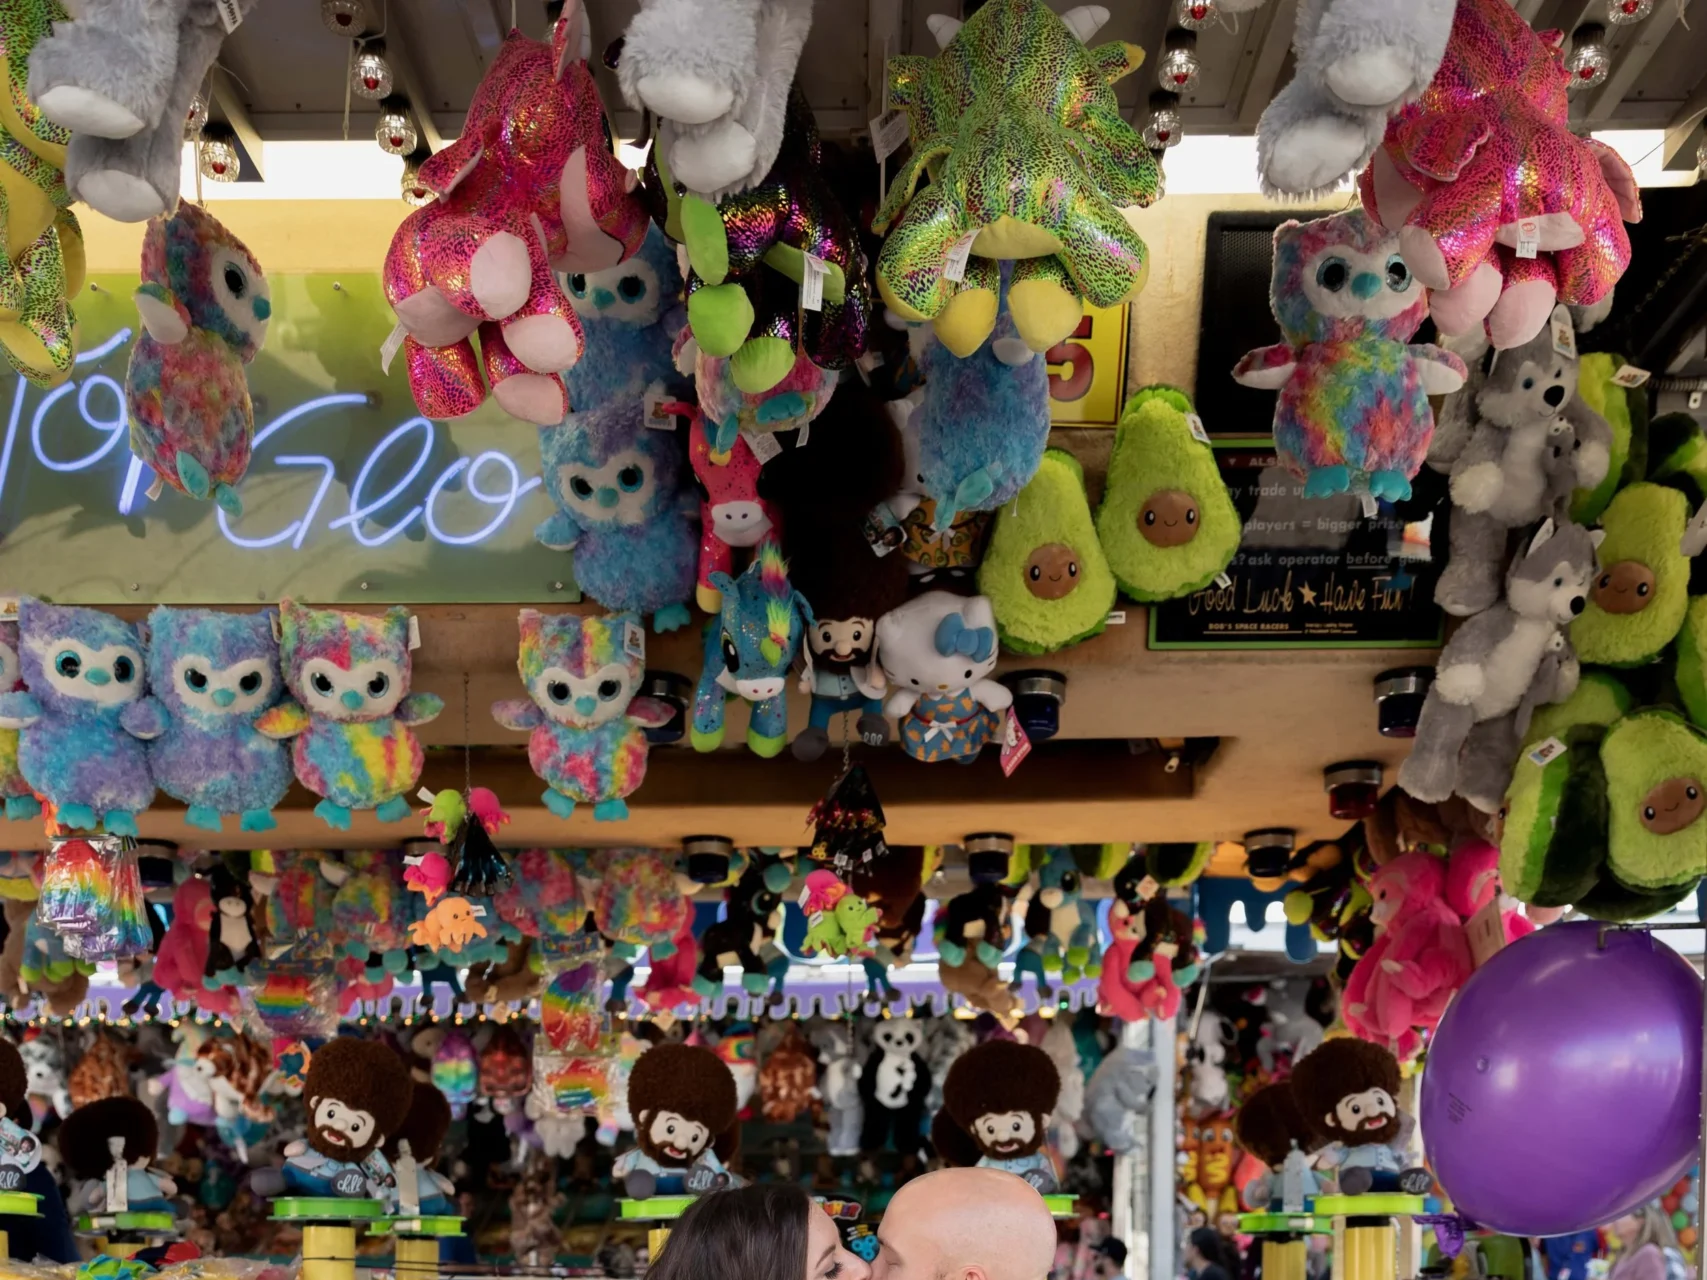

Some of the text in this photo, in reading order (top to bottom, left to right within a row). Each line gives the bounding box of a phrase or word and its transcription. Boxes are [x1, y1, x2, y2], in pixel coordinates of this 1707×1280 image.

[1247, 483, 1287, 496] trade
[1243, 518, 1296, 535] players
[1317, 518, 1362, 536] bigger
[1248, 553, 1272, 565] ask
[1278, 555, 1341, 567] operator
[1346, 553, 1392, 565] before
[1242, 570, 1294, 615] Luck
[1319, 571, 1366, 615] Have
